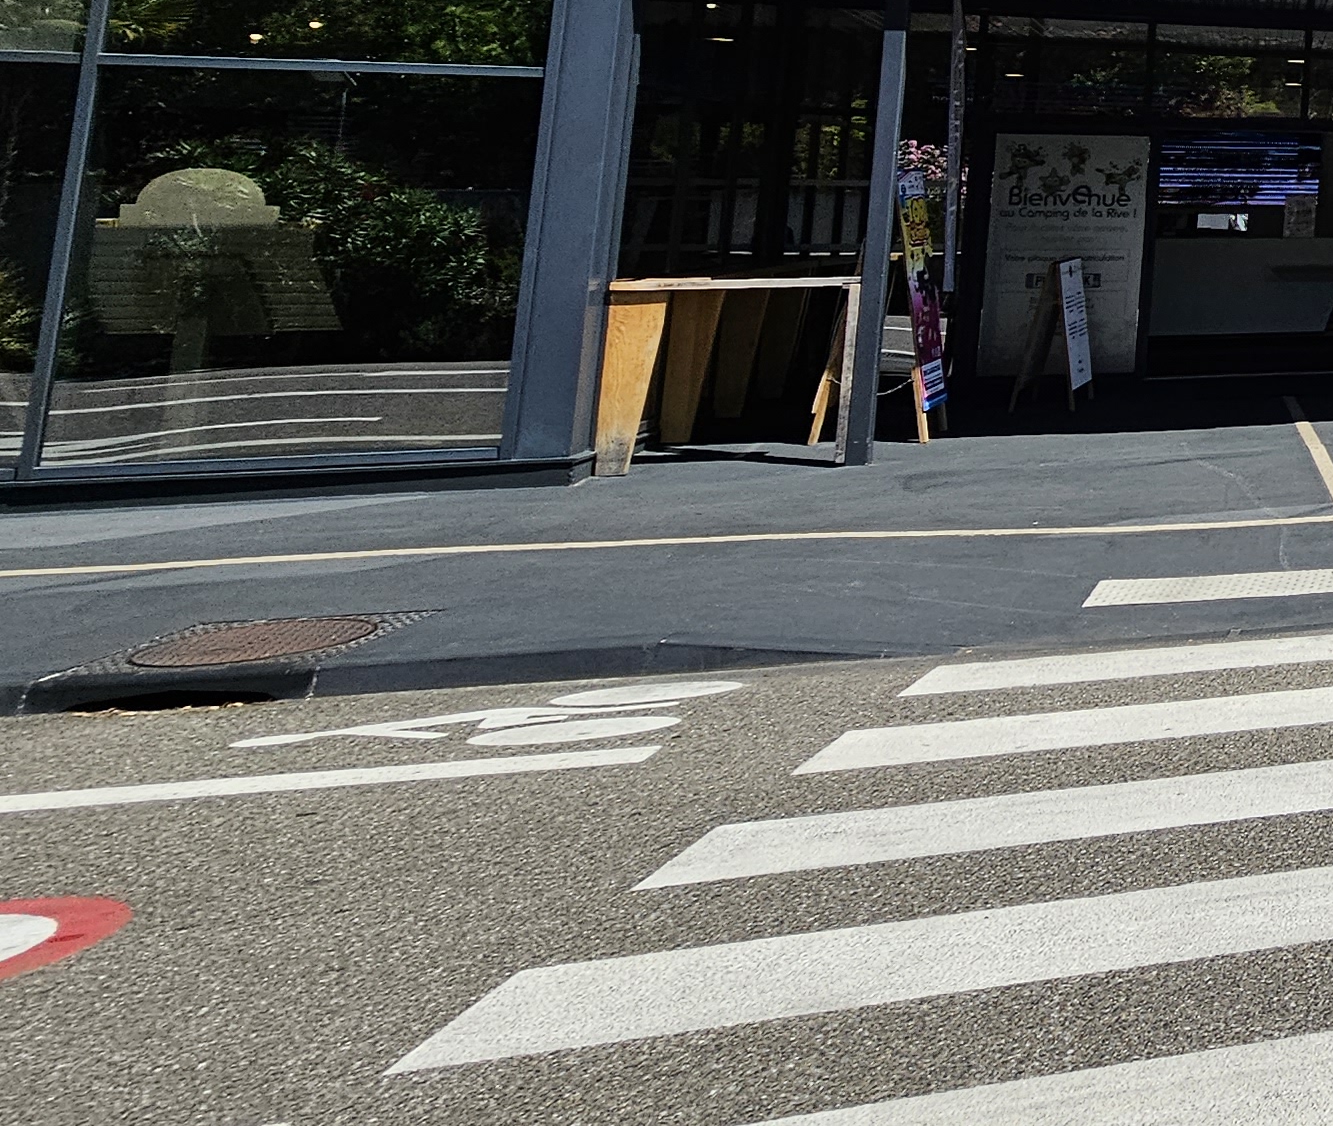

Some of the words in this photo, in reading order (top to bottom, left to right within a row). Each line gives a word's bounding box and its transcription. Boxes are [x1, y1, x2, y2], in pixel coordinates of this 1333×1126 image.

[999, 210, 1015, 218] au
[1018, 207, 1070, 221] Camping
[1073, 208, 1089, 218] de
[1092, 208, 1103, 218] la
[1106, 208, 1130, 219] Rive
